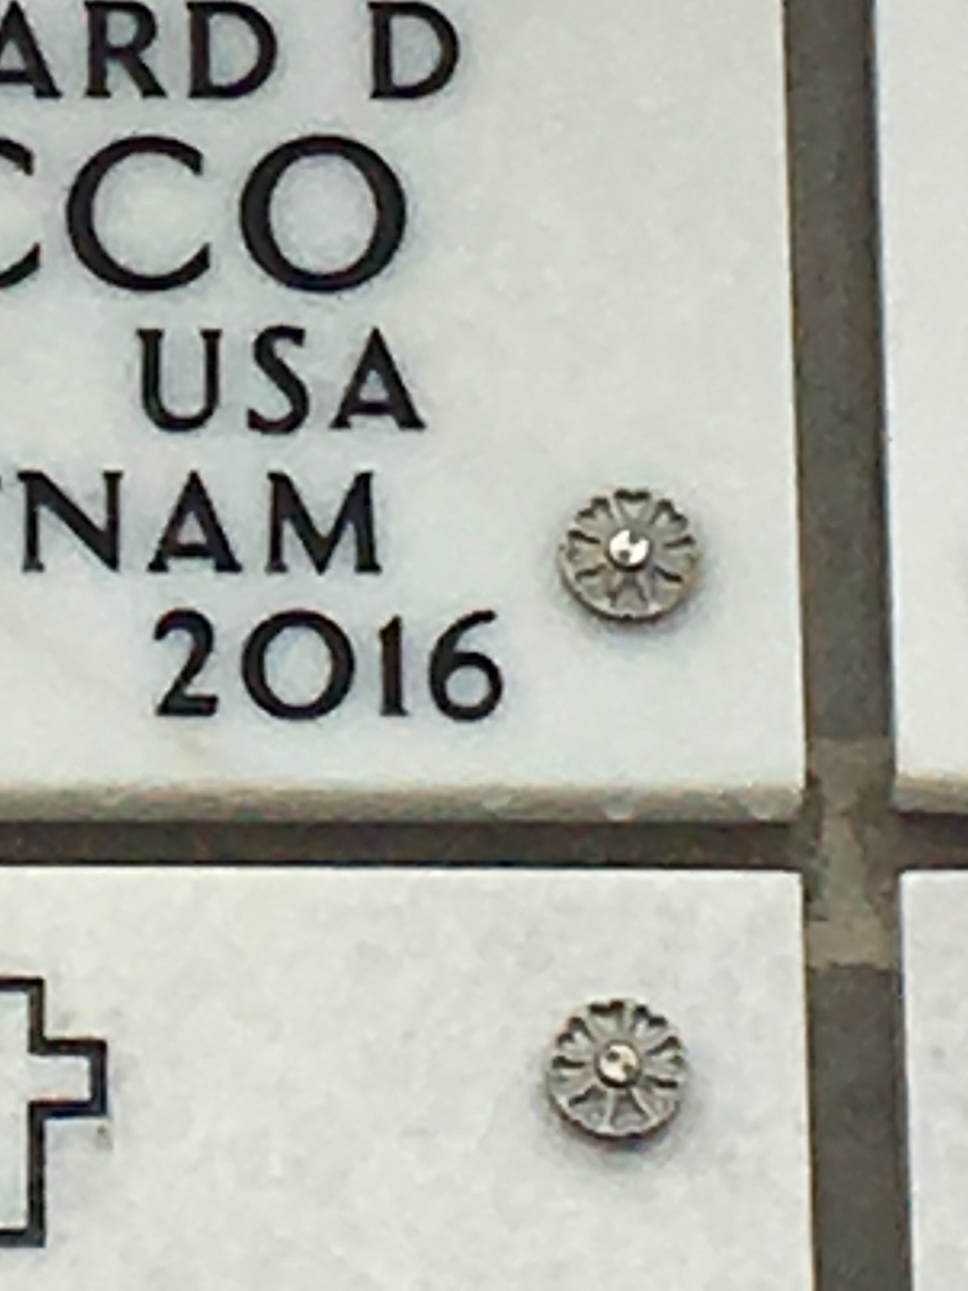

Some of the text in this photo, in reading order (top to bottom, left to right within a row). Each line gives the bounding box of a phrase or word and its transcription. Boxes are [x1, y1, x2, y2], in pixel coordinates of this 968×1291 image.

[365, 0, 461, 102] D
[134, 323, 428, 437] USA
[152, 607, 505, 724] 2016
